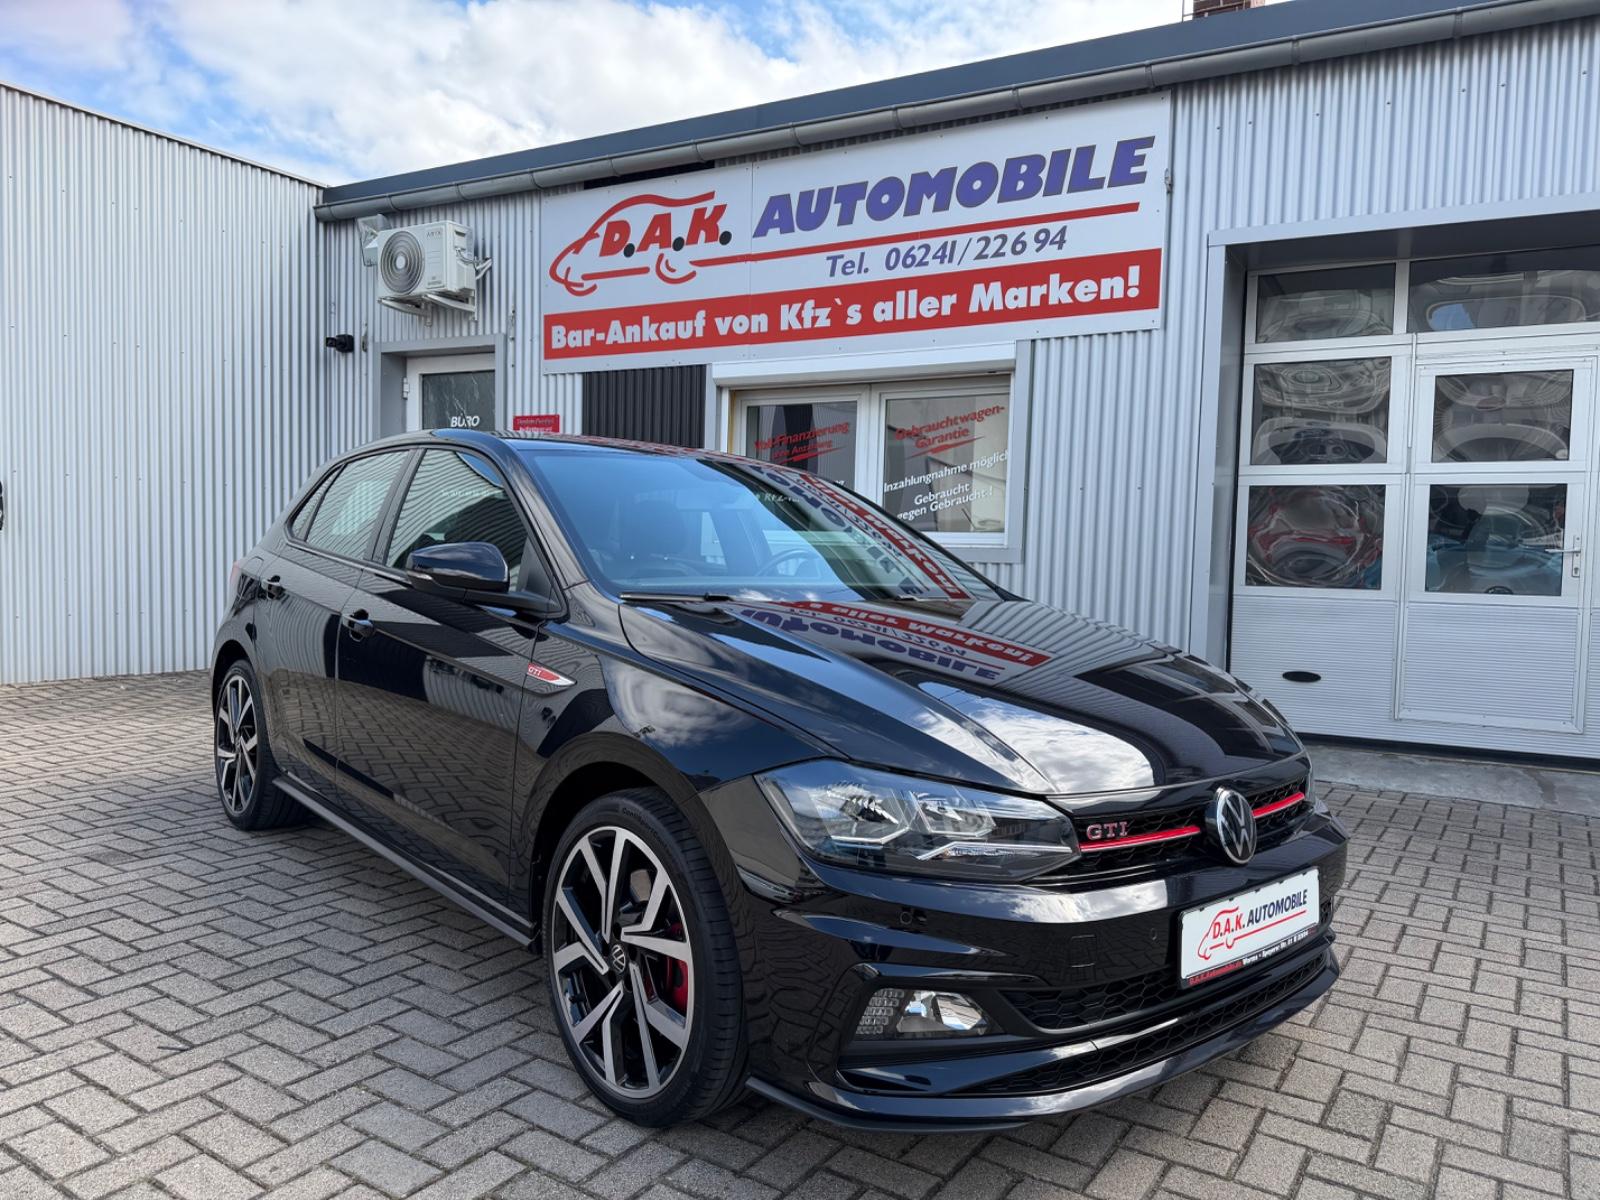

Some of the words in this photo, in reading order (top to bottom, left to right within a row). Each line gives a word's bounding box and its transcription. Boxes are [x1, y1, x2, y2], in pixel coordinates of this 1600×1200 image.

[599, 204, 732, 258] D.A.K.
[752, 136, 1156, 239] AUTOMOBILE
[826, 252, 869, 278] Tel.
[551, 310, 706, 349] Bar-Ankauf
[714, 313, 768, 336] von
[873, 289, 957, 323] aller
[968, 265, 1141, 313] Marken!
[895, 405, 1005, 440] Gebrauchtwagen-
[915, 427, 970, 448] Garantie
[884, 464, 968, 493] Inzahlungnahme
[914, 483, 970, 505] Gebraucht
[528, 667, 542, 677] GTI
[1086, 821, 1128, 840] GTI
[1212, 913, 1246, 939] D.A.K.
[1246, 888, 1308, 928] AUTOMOBILE
